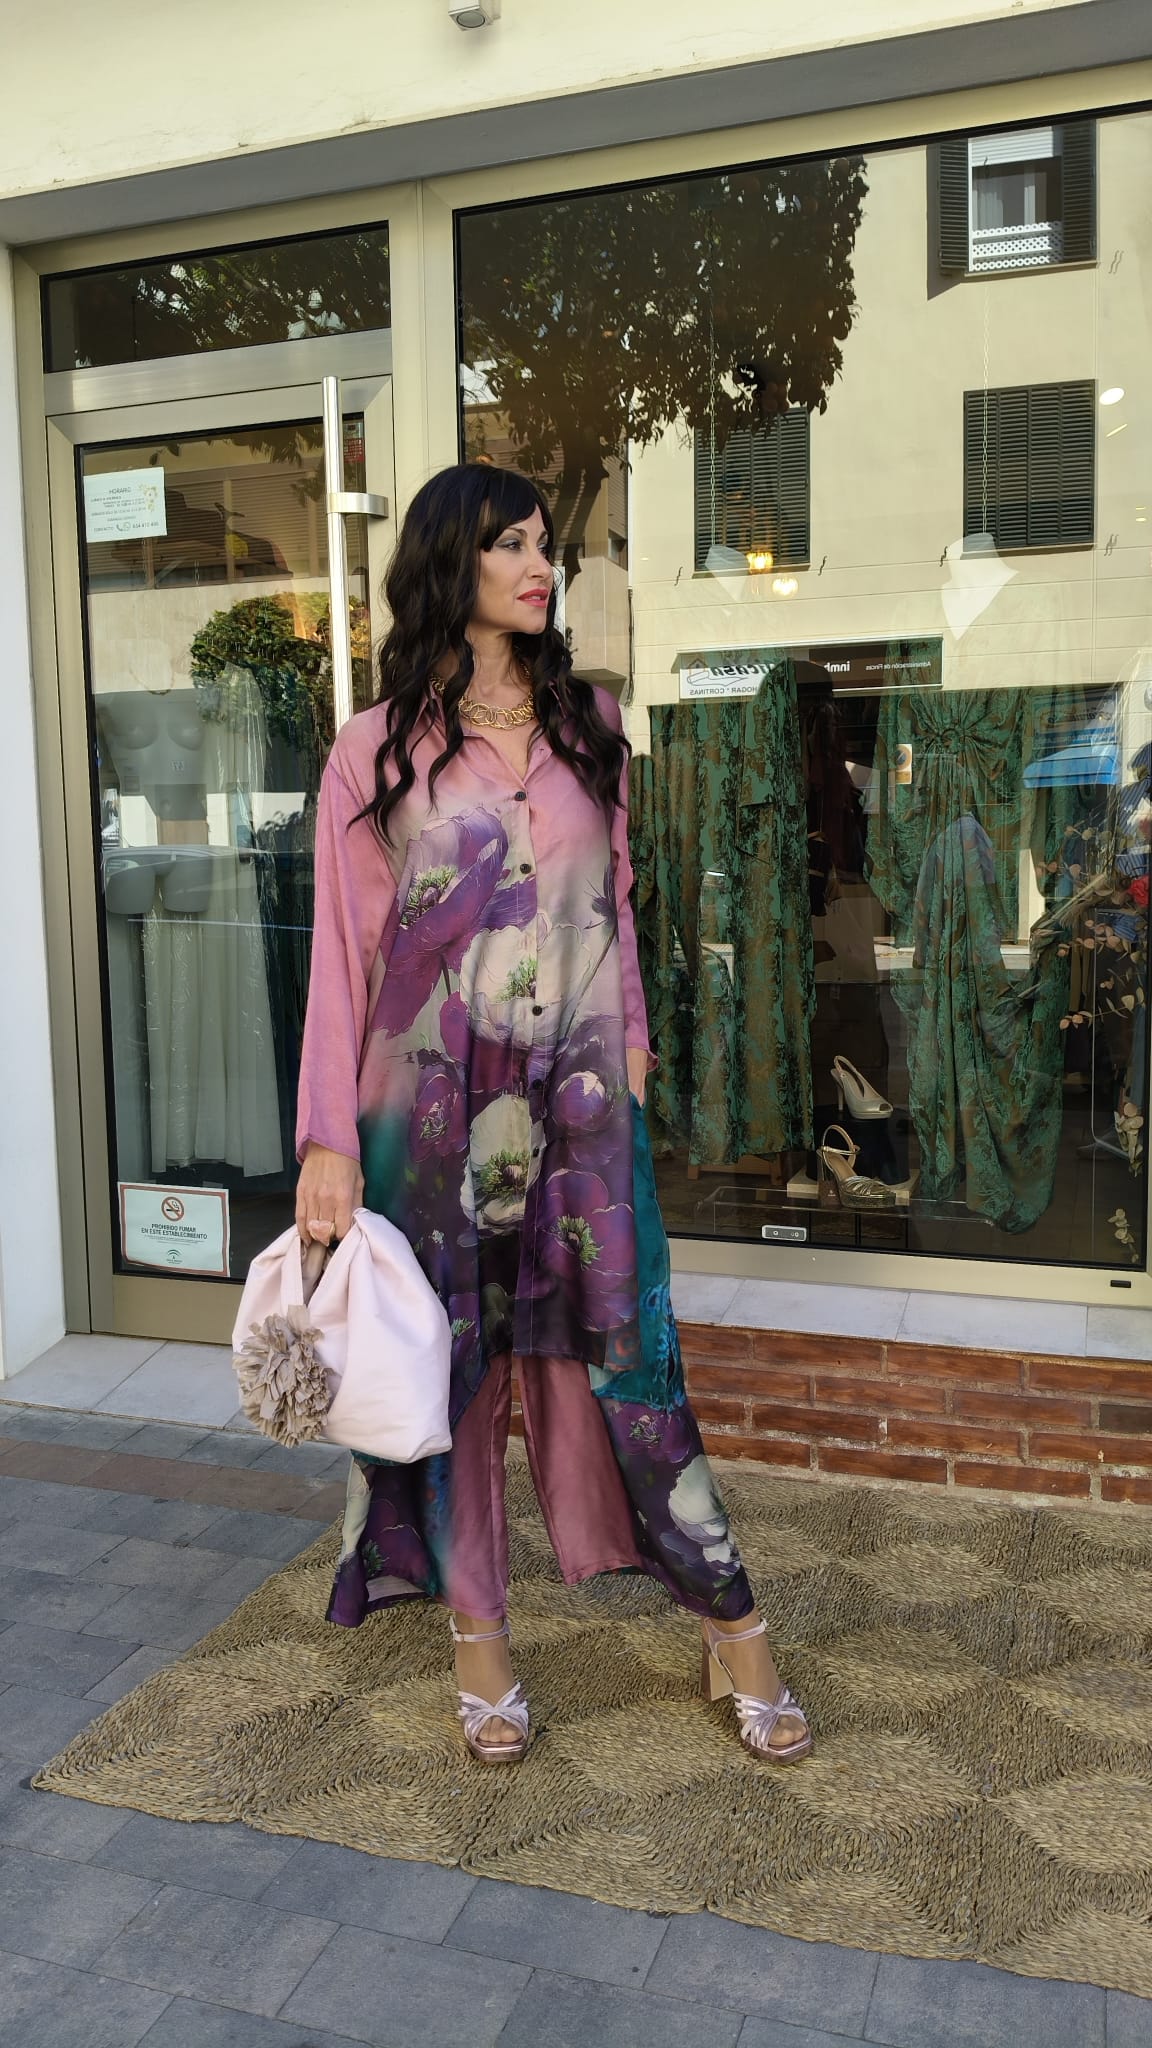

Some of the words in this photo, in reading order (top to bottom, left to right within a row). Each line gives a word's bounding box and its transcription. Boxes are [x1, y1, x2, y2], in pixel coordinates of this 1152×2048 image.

[151, 1223, 179, 1231] PROHIBIDO
[179, 1225, 196, 1233] FUMAR
[162, 1230, 208, 1239] ESTABLECIMIENTO
